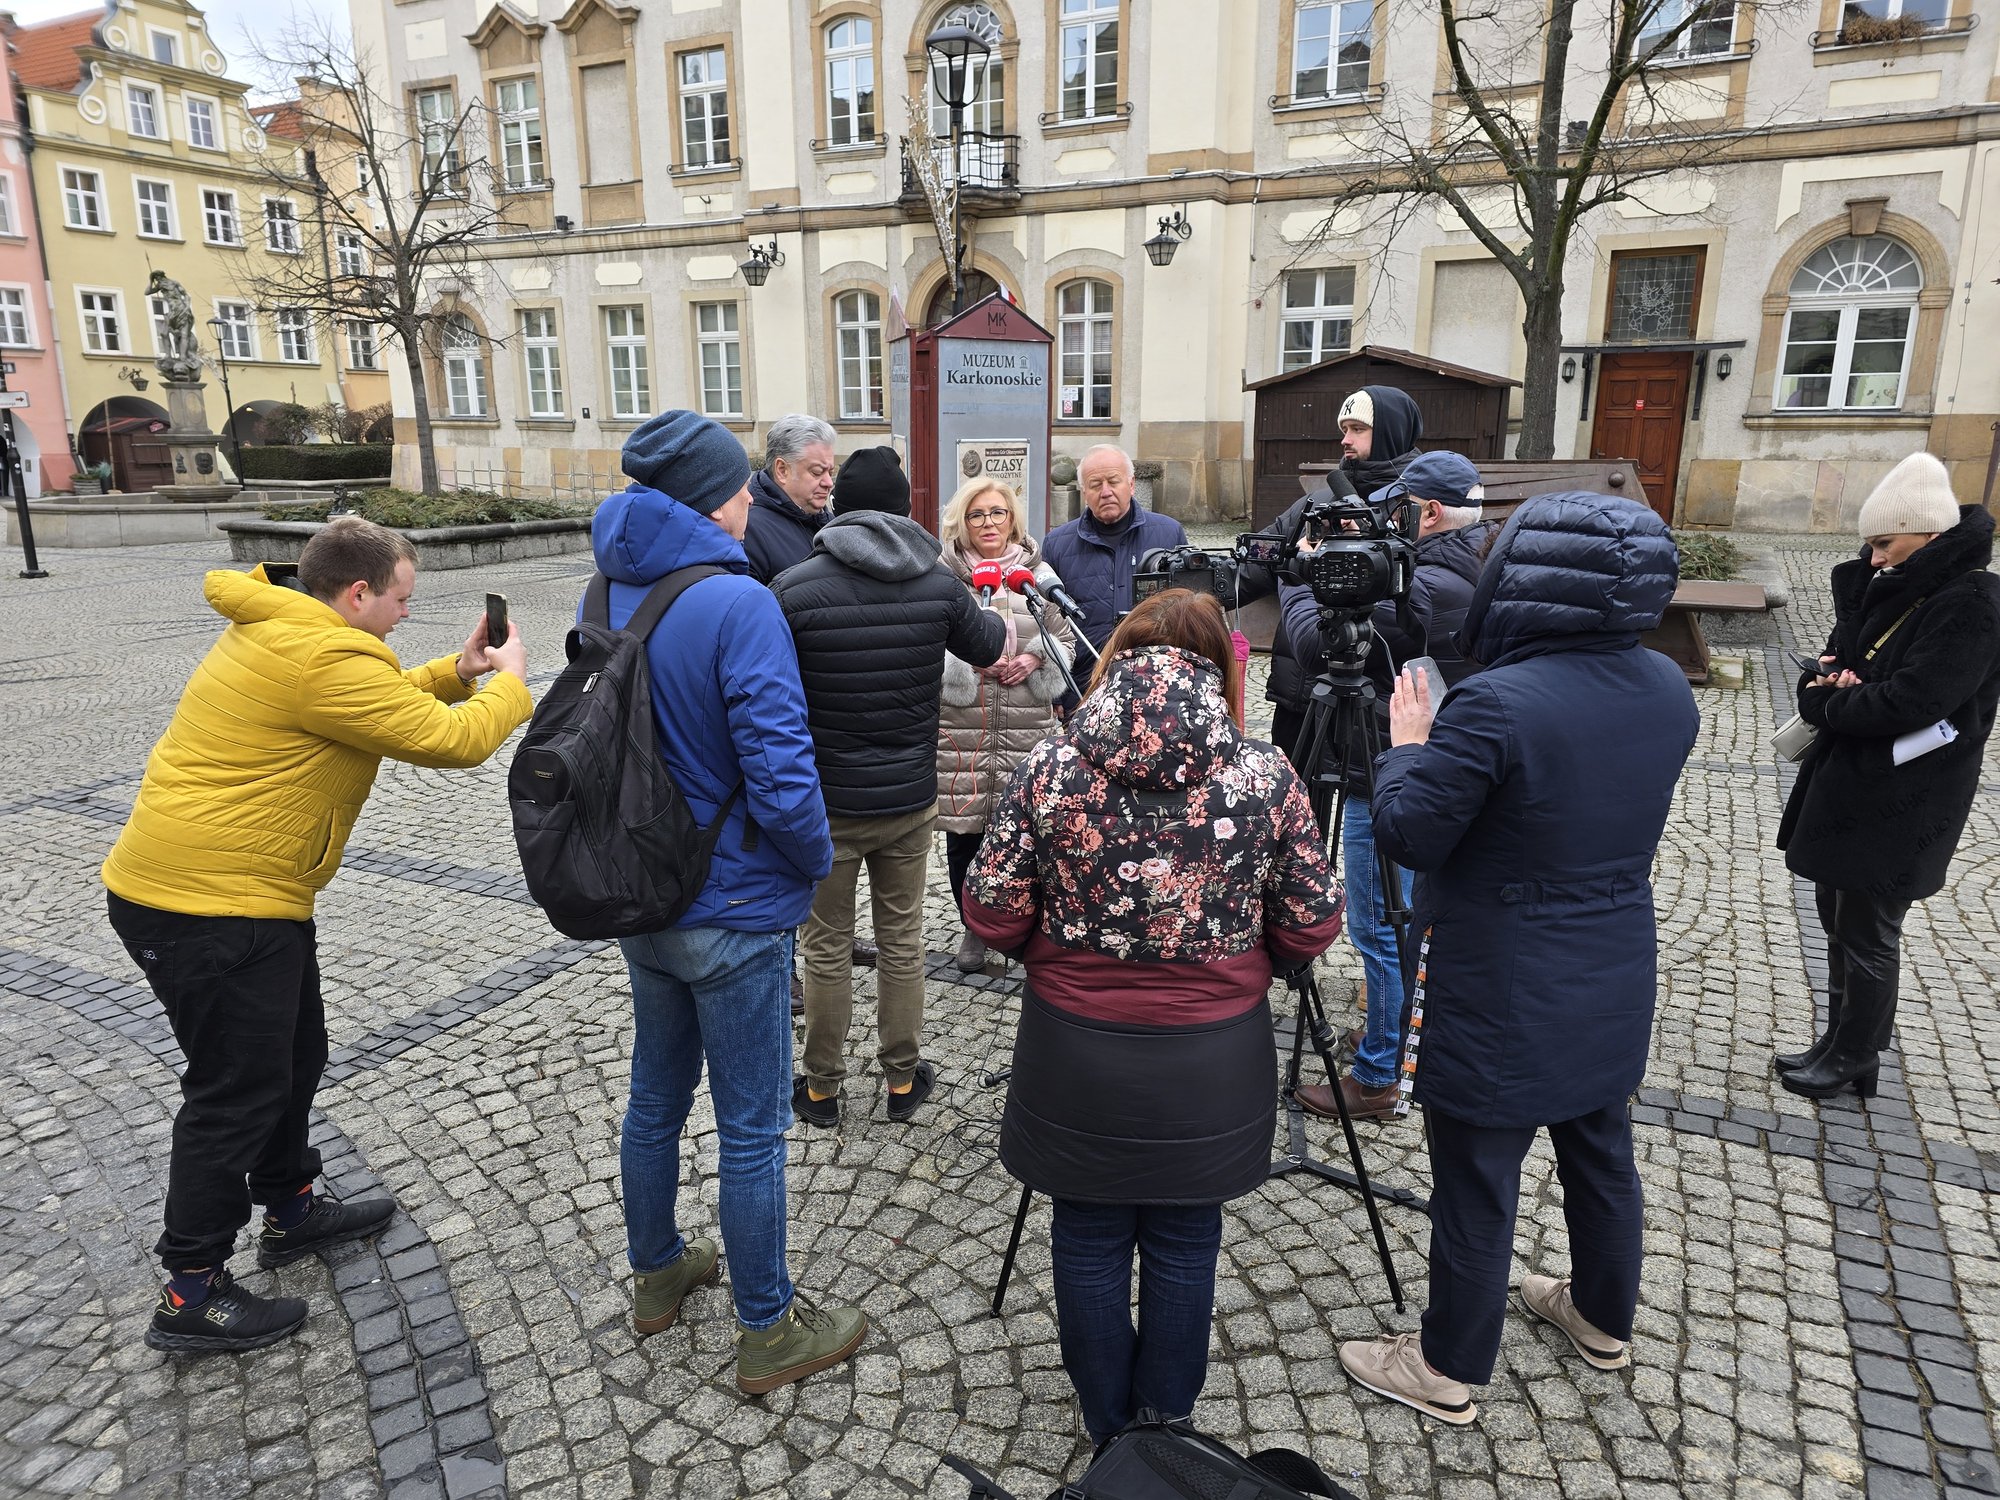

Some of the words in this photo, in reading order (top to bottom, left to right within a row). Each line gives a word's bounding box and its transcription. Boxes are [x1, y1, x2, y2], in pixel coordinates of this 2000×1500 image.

[987, 311, 1007, 327] MK
[963, 353, 1016, 369] MUZEUM
[946, 369, 1043, 386] Karkonoskie
[985, 458, 1024, 472] CZASY
[206, 1307, 230, 1323] EA7
